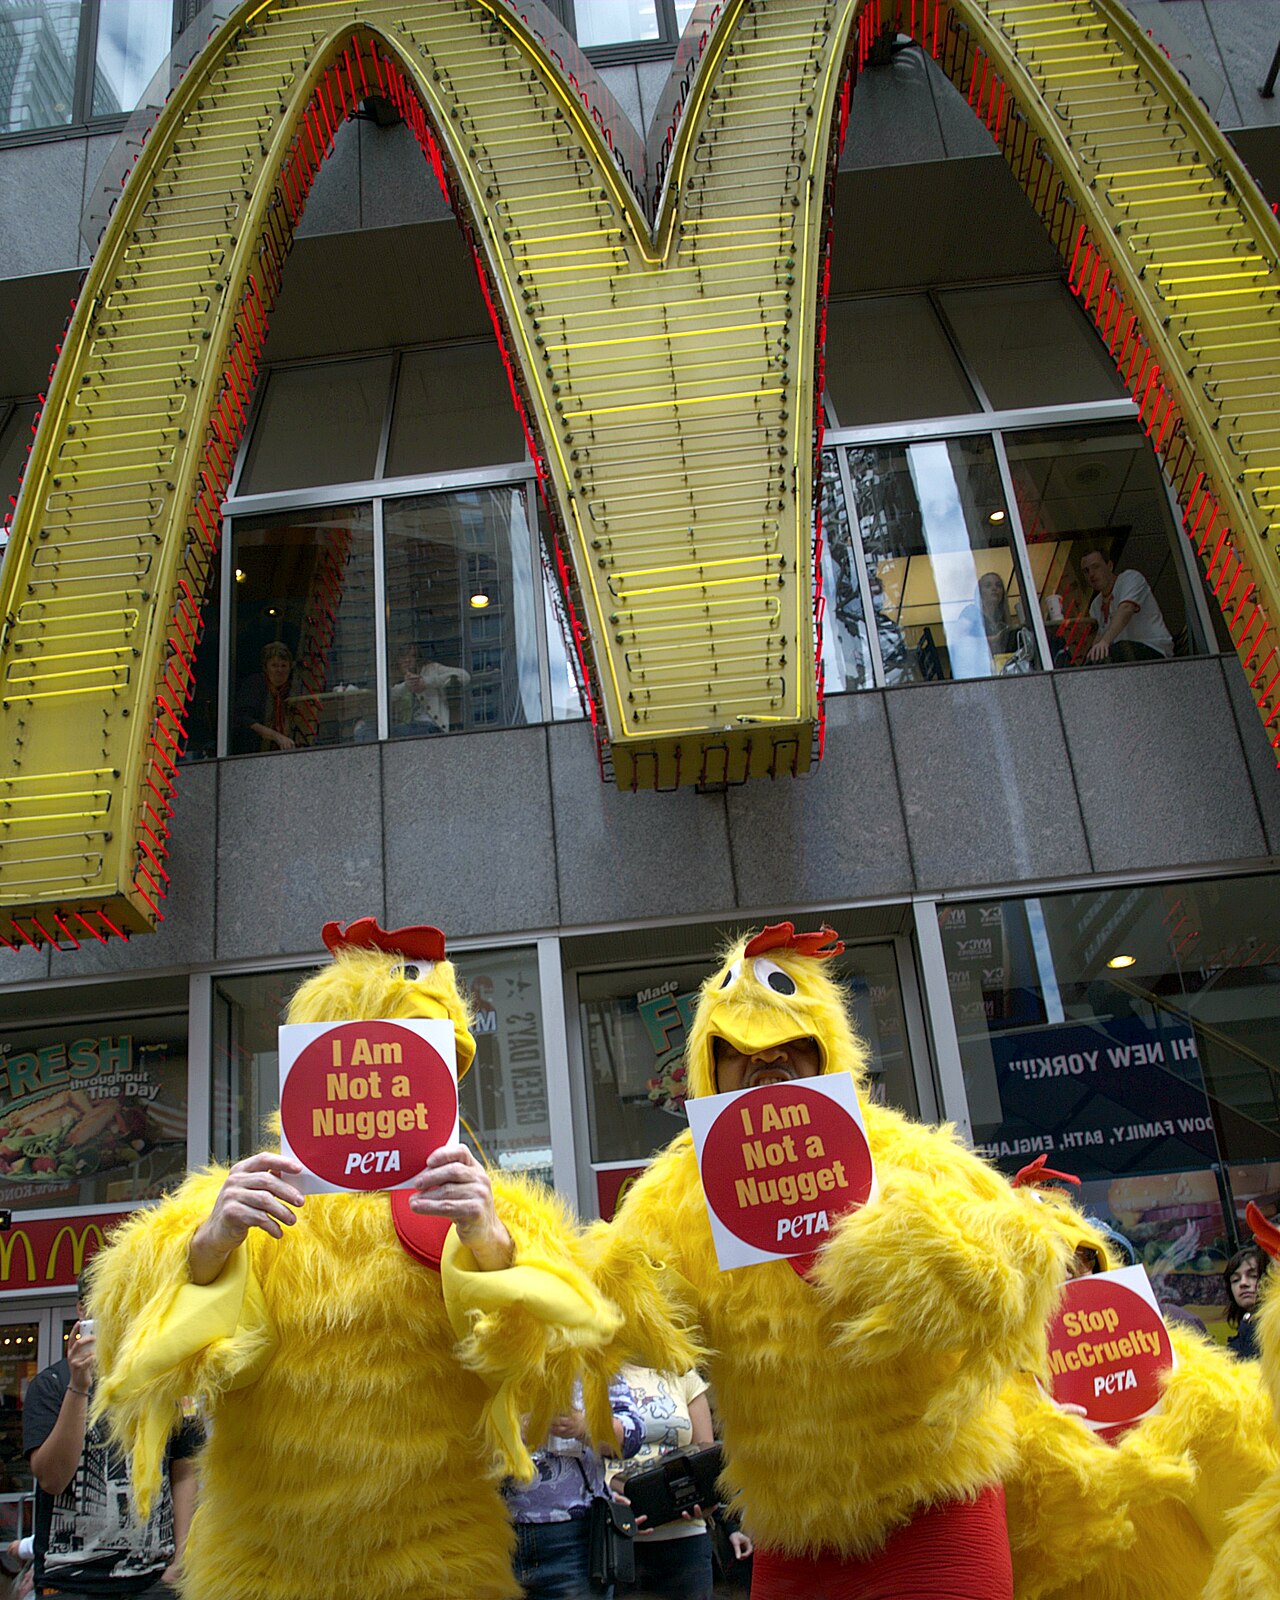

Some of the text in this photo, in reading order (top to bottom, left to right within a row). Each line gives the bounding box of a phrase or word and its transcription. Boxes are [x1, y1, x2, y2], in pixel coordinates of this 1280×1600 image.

[637, 981, 679, 1003] Made
[332, 1038, 403, 1067] I Am
[70, 1071, 150, 1090] throughout
[87, 1082, 161, 1100] The Day
[326, 1071, 411, 1101] Not a
[312, 1102, 429, 1141] Nugget
[740, 1103, 811, 1136] I Am
[741, 1134, 826, 1171] Not a
[734, 1159, 849, 1209] Nugget
[1062, 1306, 1120, 1338] Stop
[1047, 1328, 1161, 1377] McCruelty
